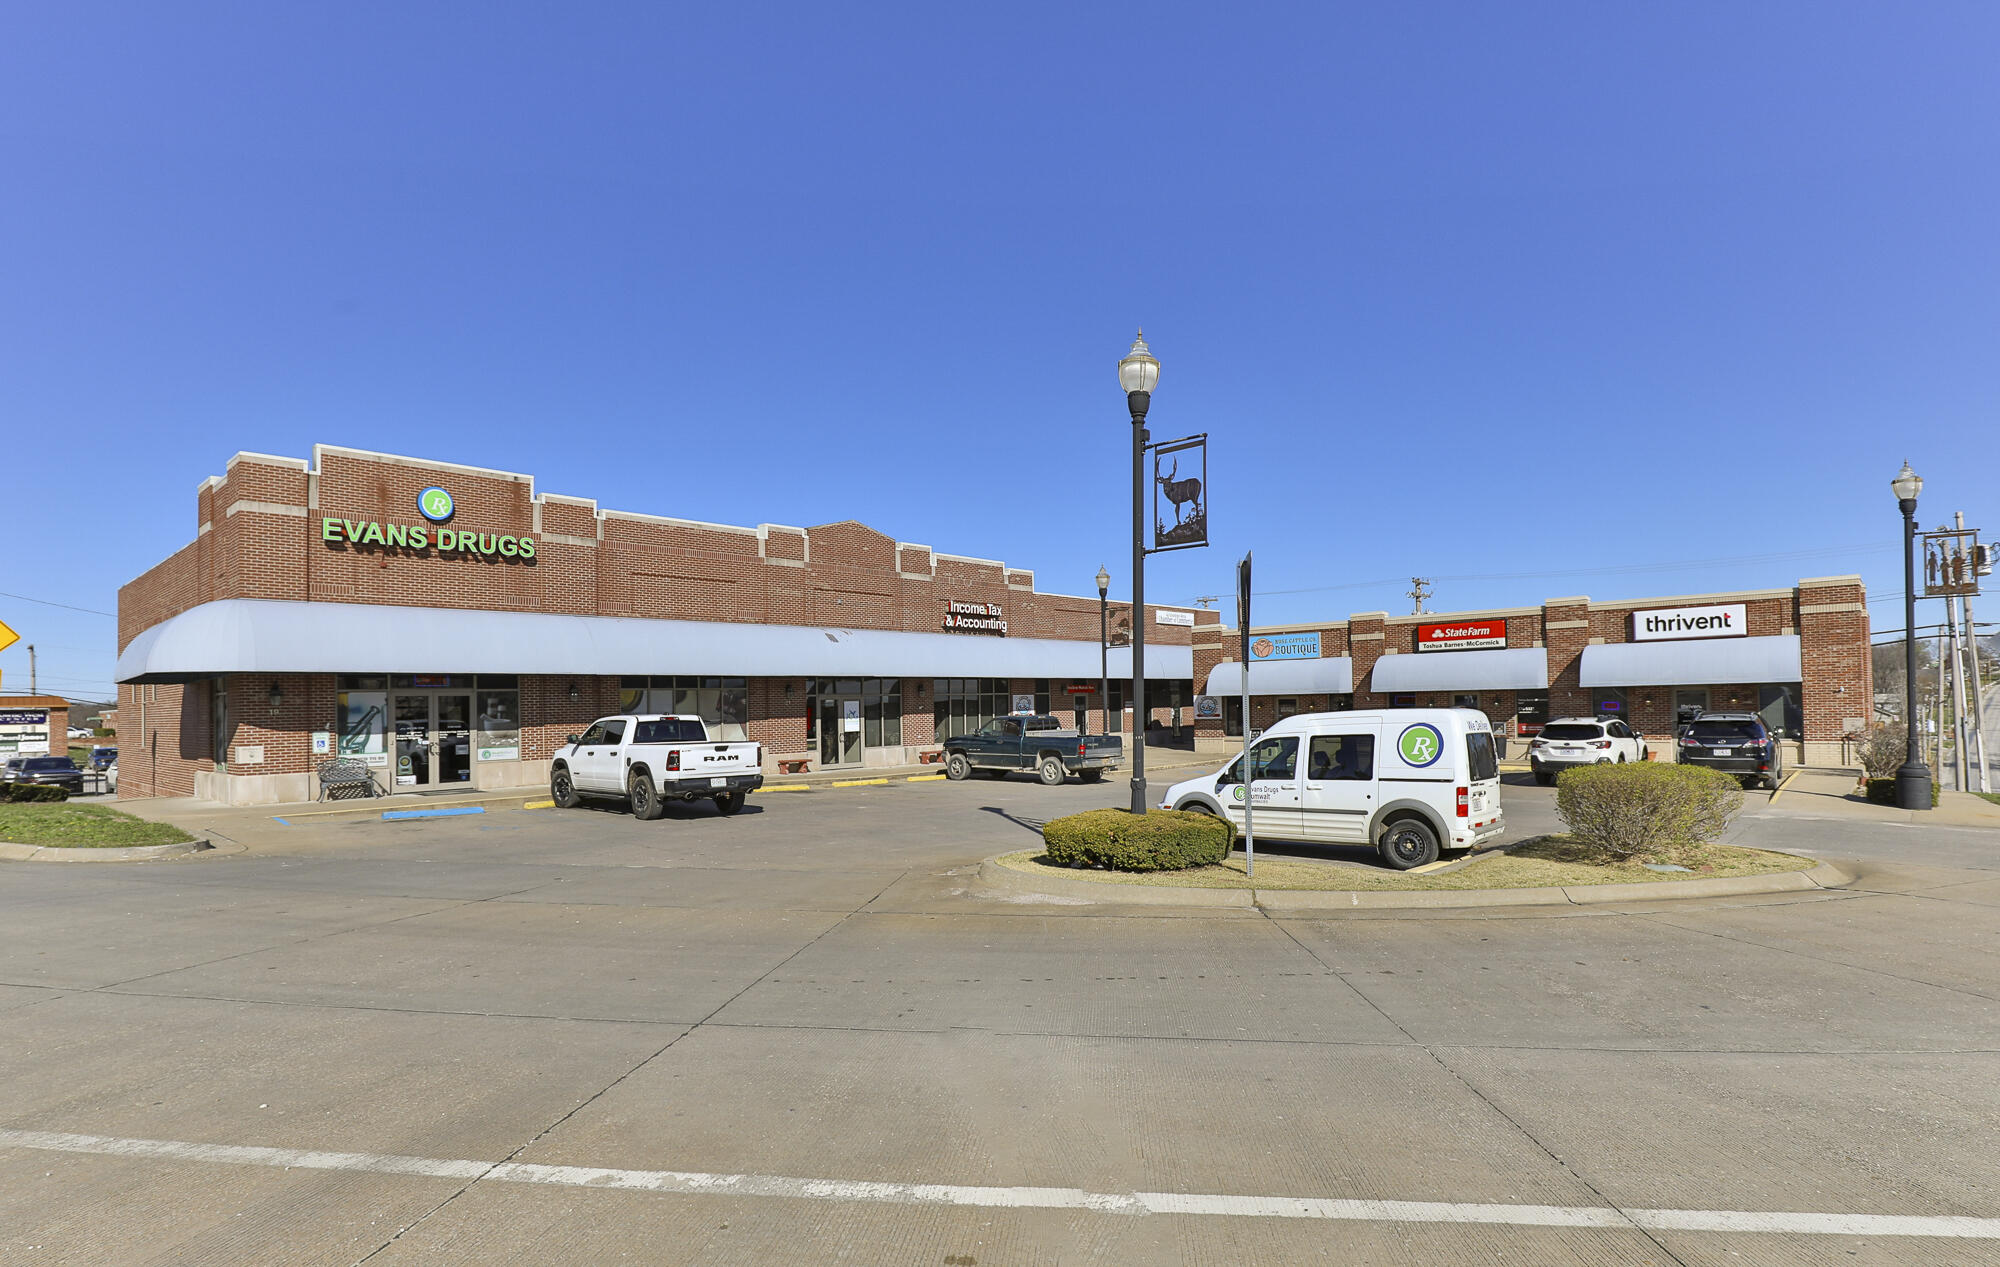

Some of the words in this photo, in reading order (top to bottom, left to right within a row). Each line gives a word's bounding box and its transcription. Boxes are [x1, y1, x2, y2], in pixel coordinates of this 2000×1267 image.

[322, 517, 428, 549] EVANS
[437, 528, 536, 558] DRUGS
[950, 600, 985, 615] Income
[986, 603, 1003, 616] Tax
[945, 615, 954, 627] &
[955, 615, 1008, 633] Accounting
[1646, 612, 1732, 633] thrivent
[1275, 643, 1318, 656] BOUTIQUE
[1263, 785, 1279, 794] Drugs
